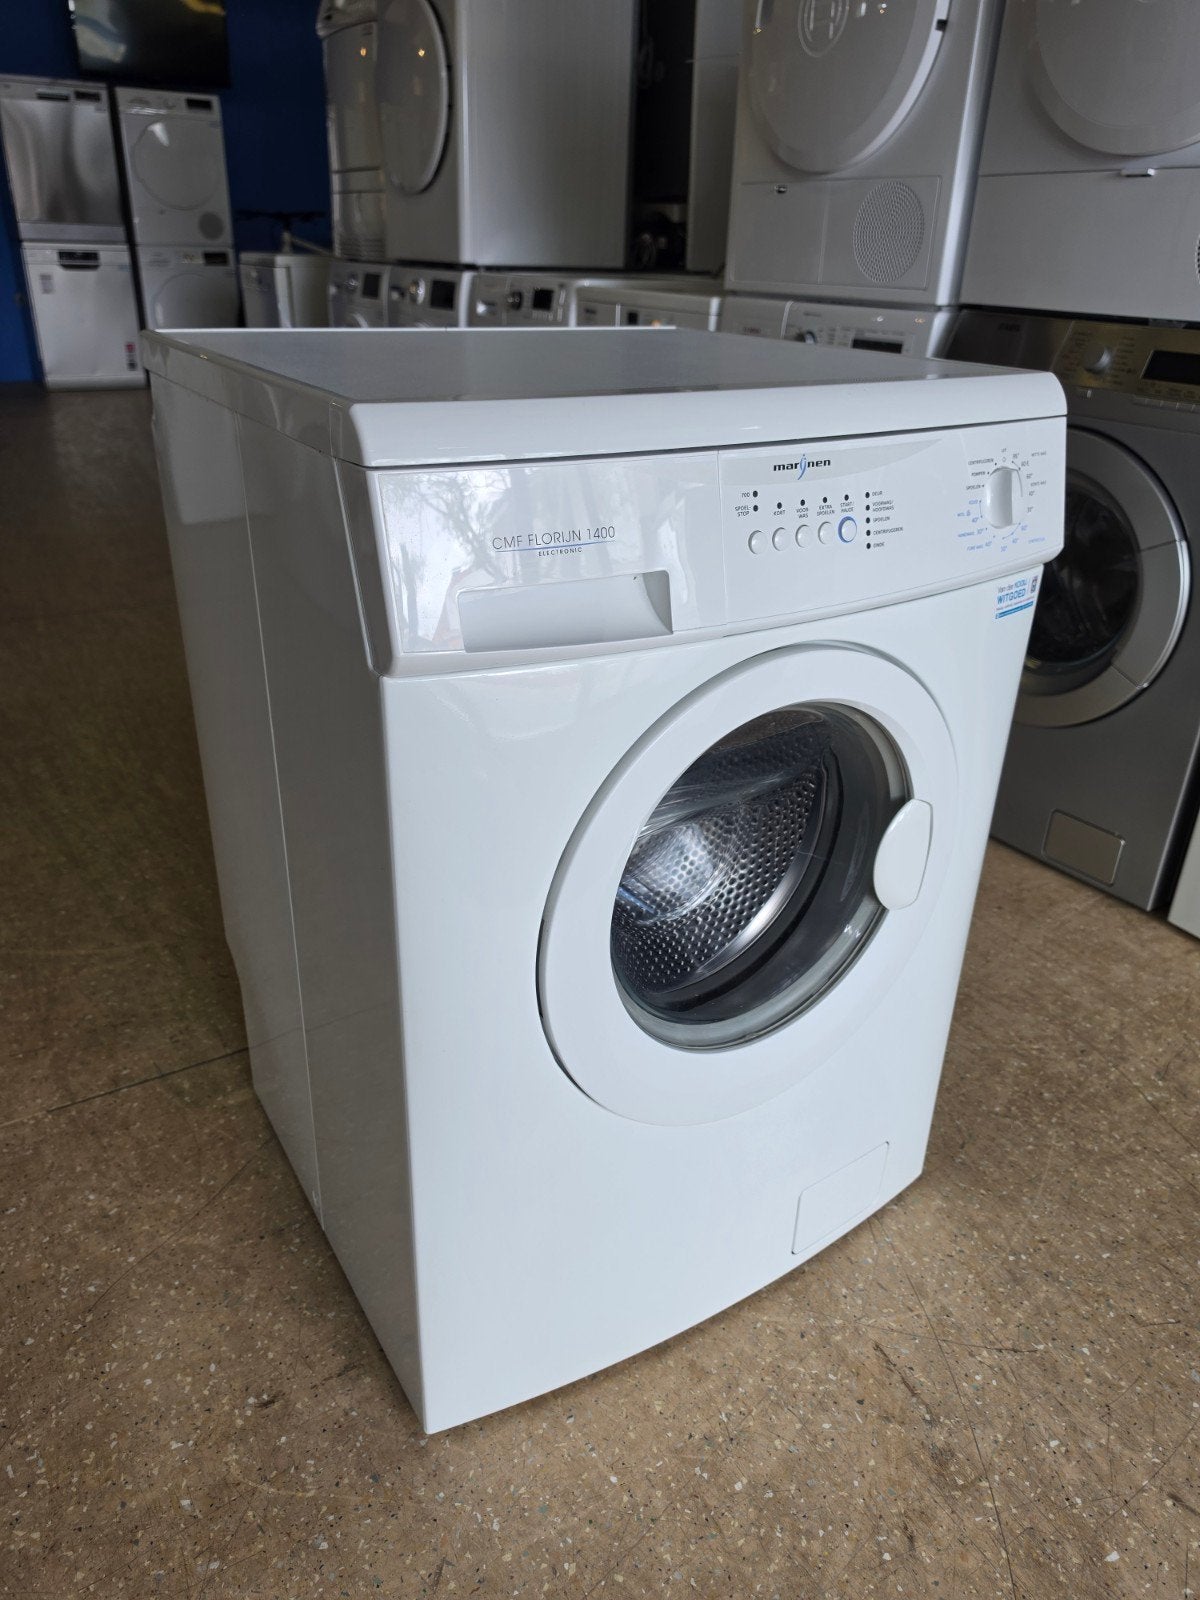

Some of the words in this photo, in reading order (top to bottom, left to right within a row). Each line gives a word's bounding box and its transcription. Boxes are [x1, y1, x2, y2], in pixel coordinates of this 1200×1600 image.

[492, 535, 522, 550] CMF
[527, 529, 581, 546] FLORIJN
[587, 526, 615, 540] 1400
[538, 547, 583, 557] ELECTRONIC
[997, 588, 1026, 605] WITGOED
